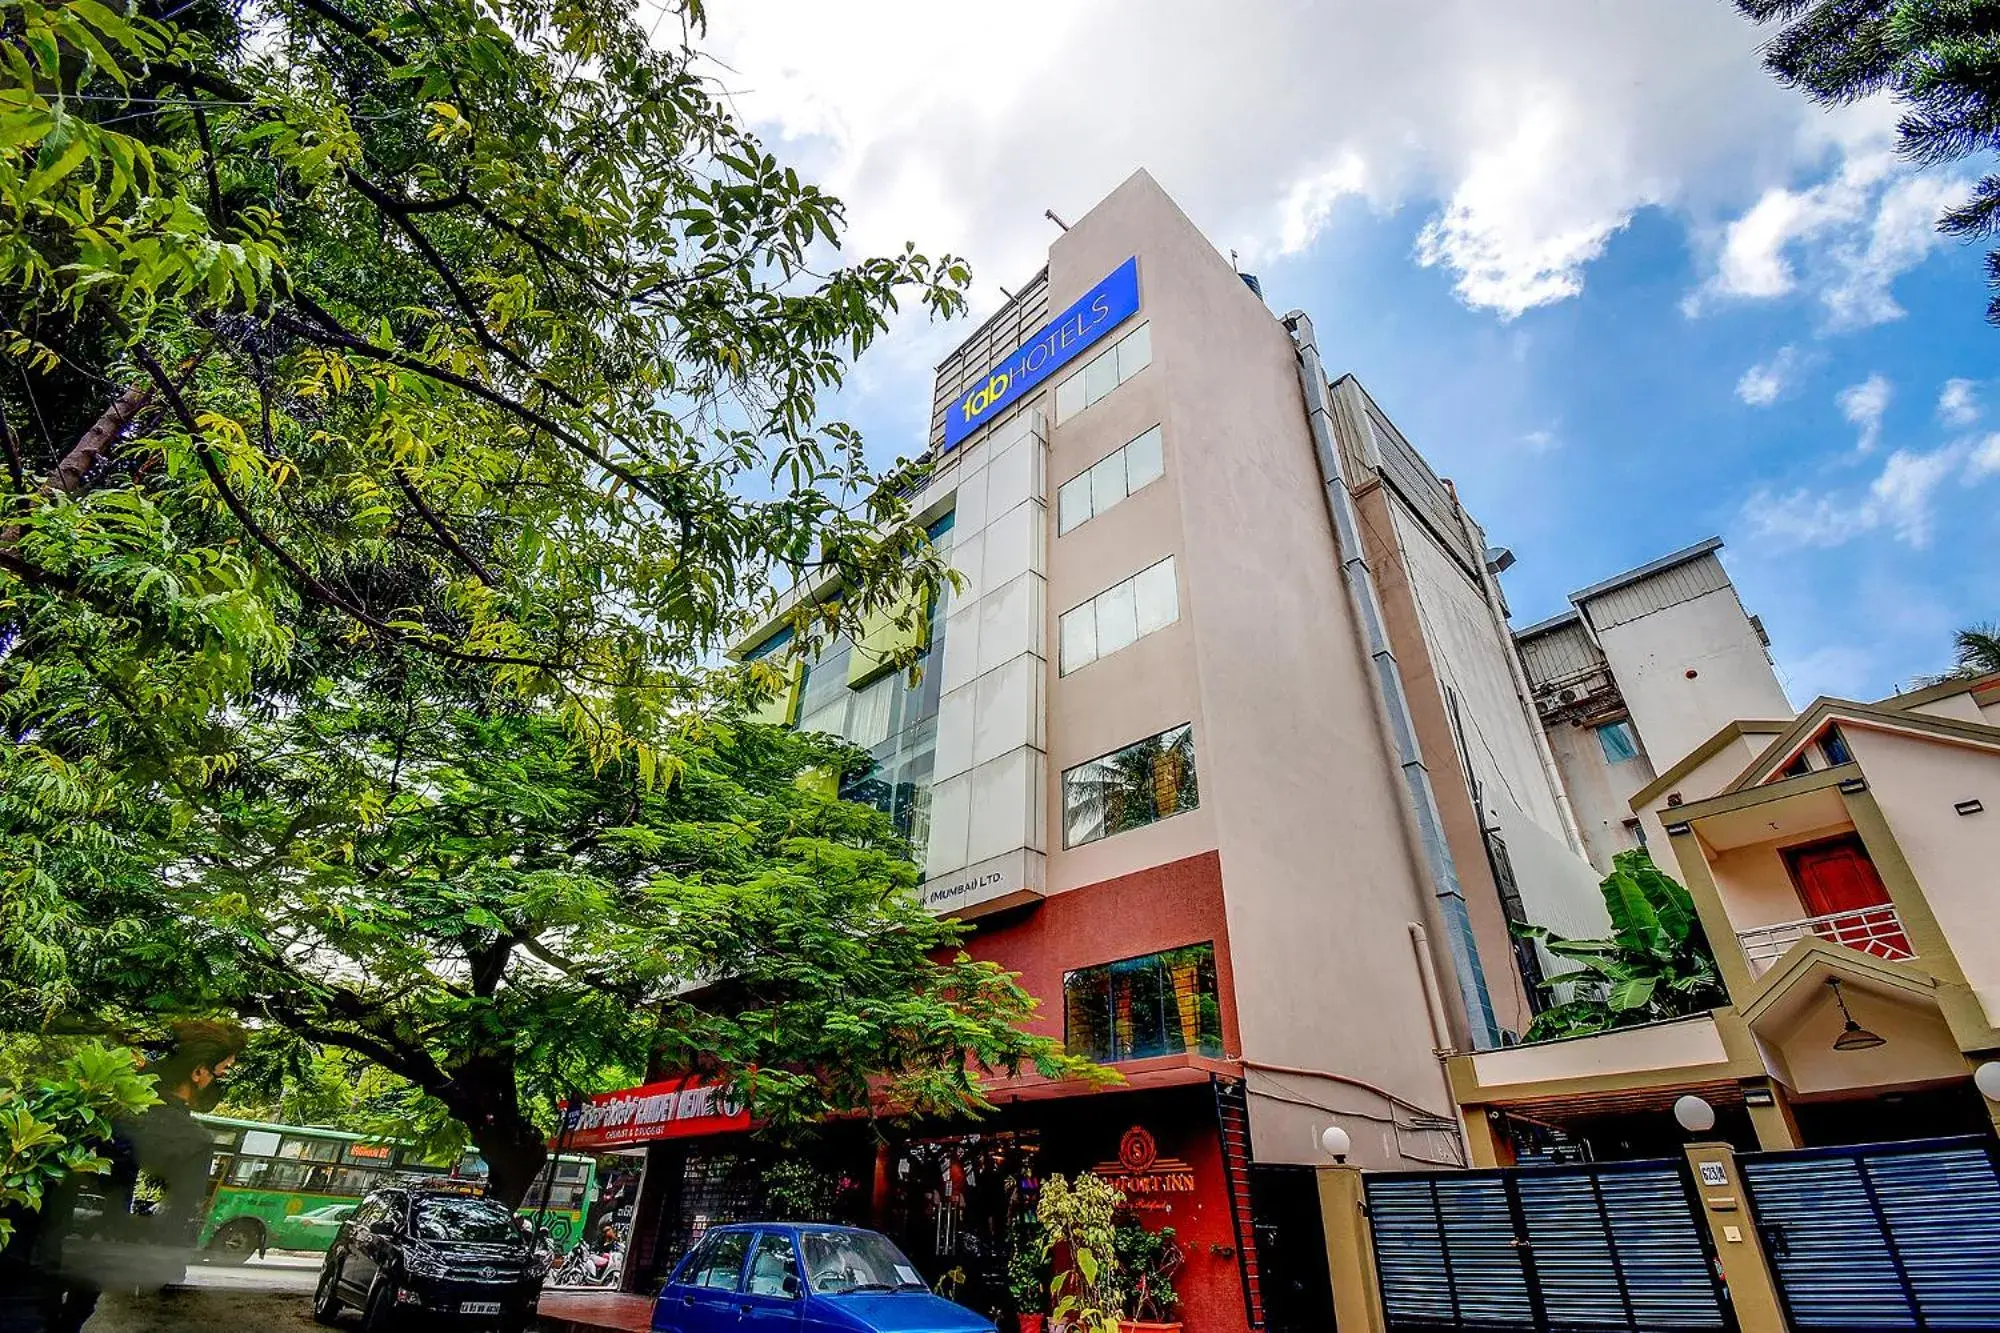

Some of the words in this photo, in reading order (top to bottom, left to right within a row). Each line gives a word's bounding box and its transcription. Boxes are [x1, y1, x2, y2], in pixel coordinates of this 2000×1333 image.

[930, 879, 977, 903] (MUMBAI)
[980, 872, 1004, 887] LTD.
[1165, 1173, 1196, 1191] INN
